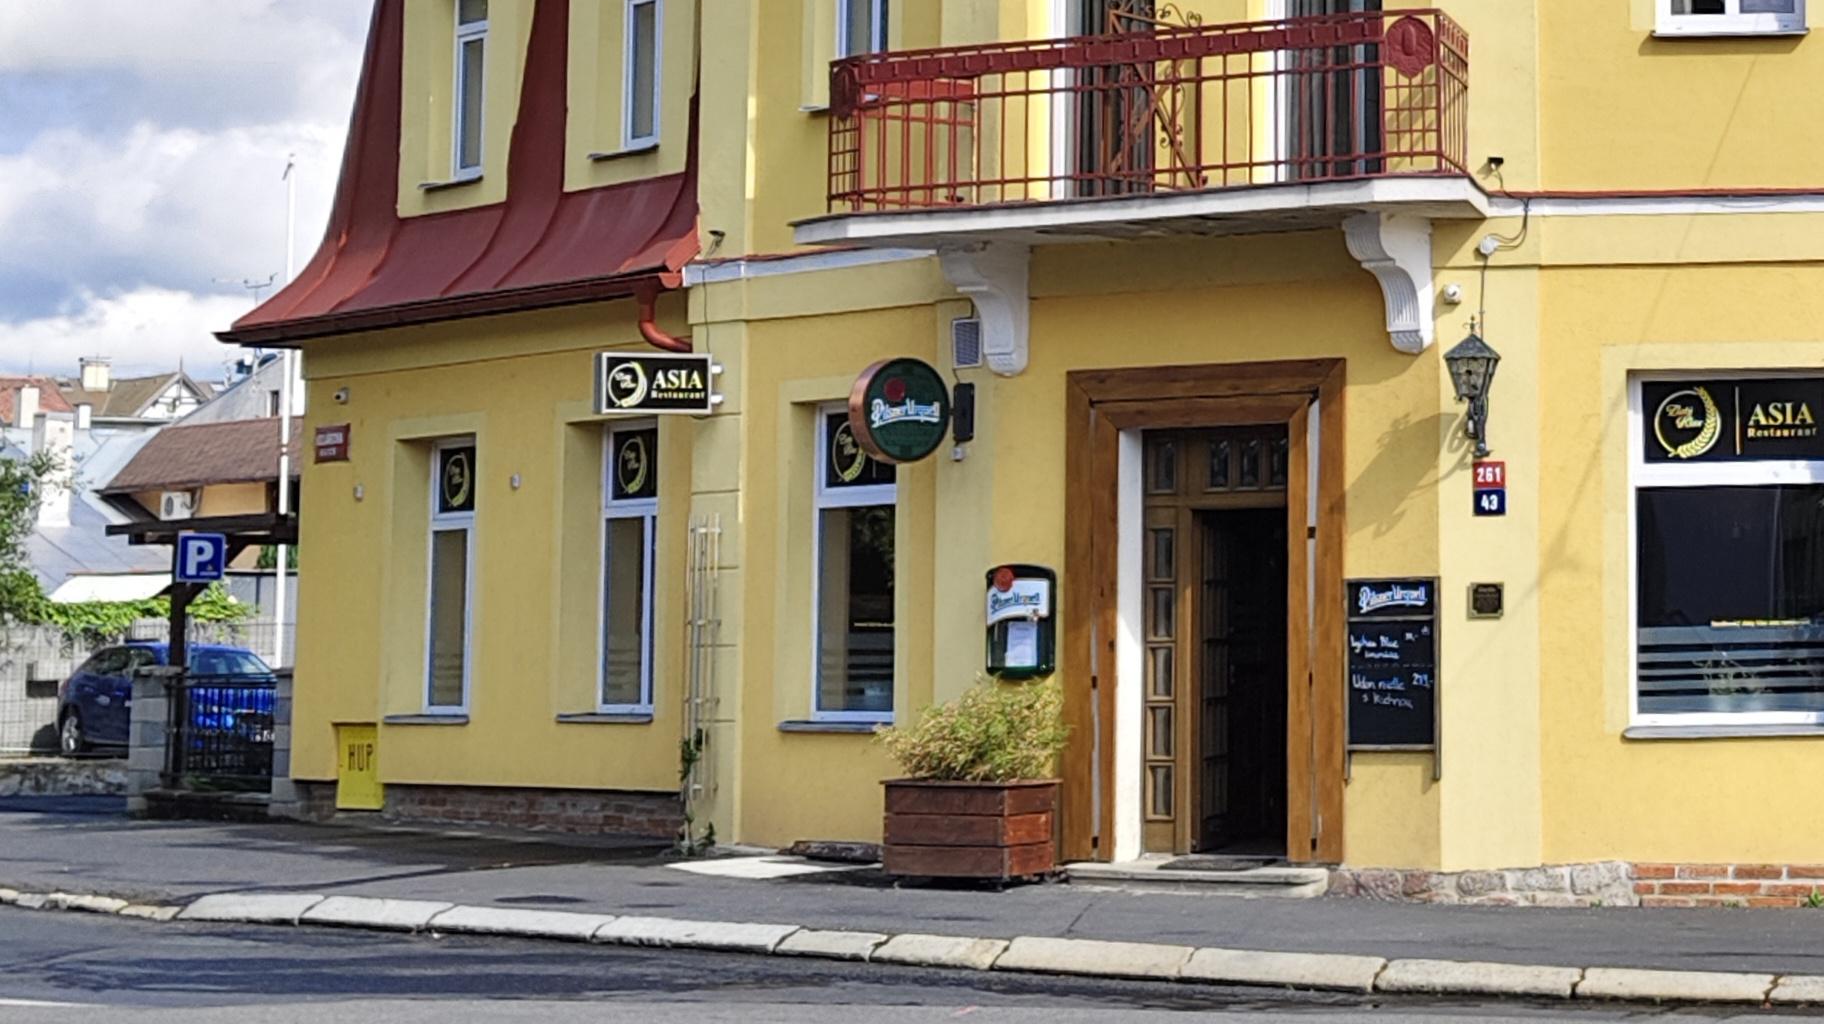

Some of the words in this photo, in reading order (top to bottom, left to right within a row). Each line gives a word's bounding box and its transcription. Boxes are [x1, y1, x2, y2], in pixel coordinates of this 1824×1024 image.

[652, 369, 703, 389] ASIA
[650, 390, 706, 399] Restaurant
[1748, 402, 1815, 425] ASIA
[1747, 427, 1818, 438] Restaurant
[1477, 467, 1502, 483] 261
[1480, 494, 1498, 511] 43
[186, 540, 214, 576] P
[348, 743, 373, 772] HUP
